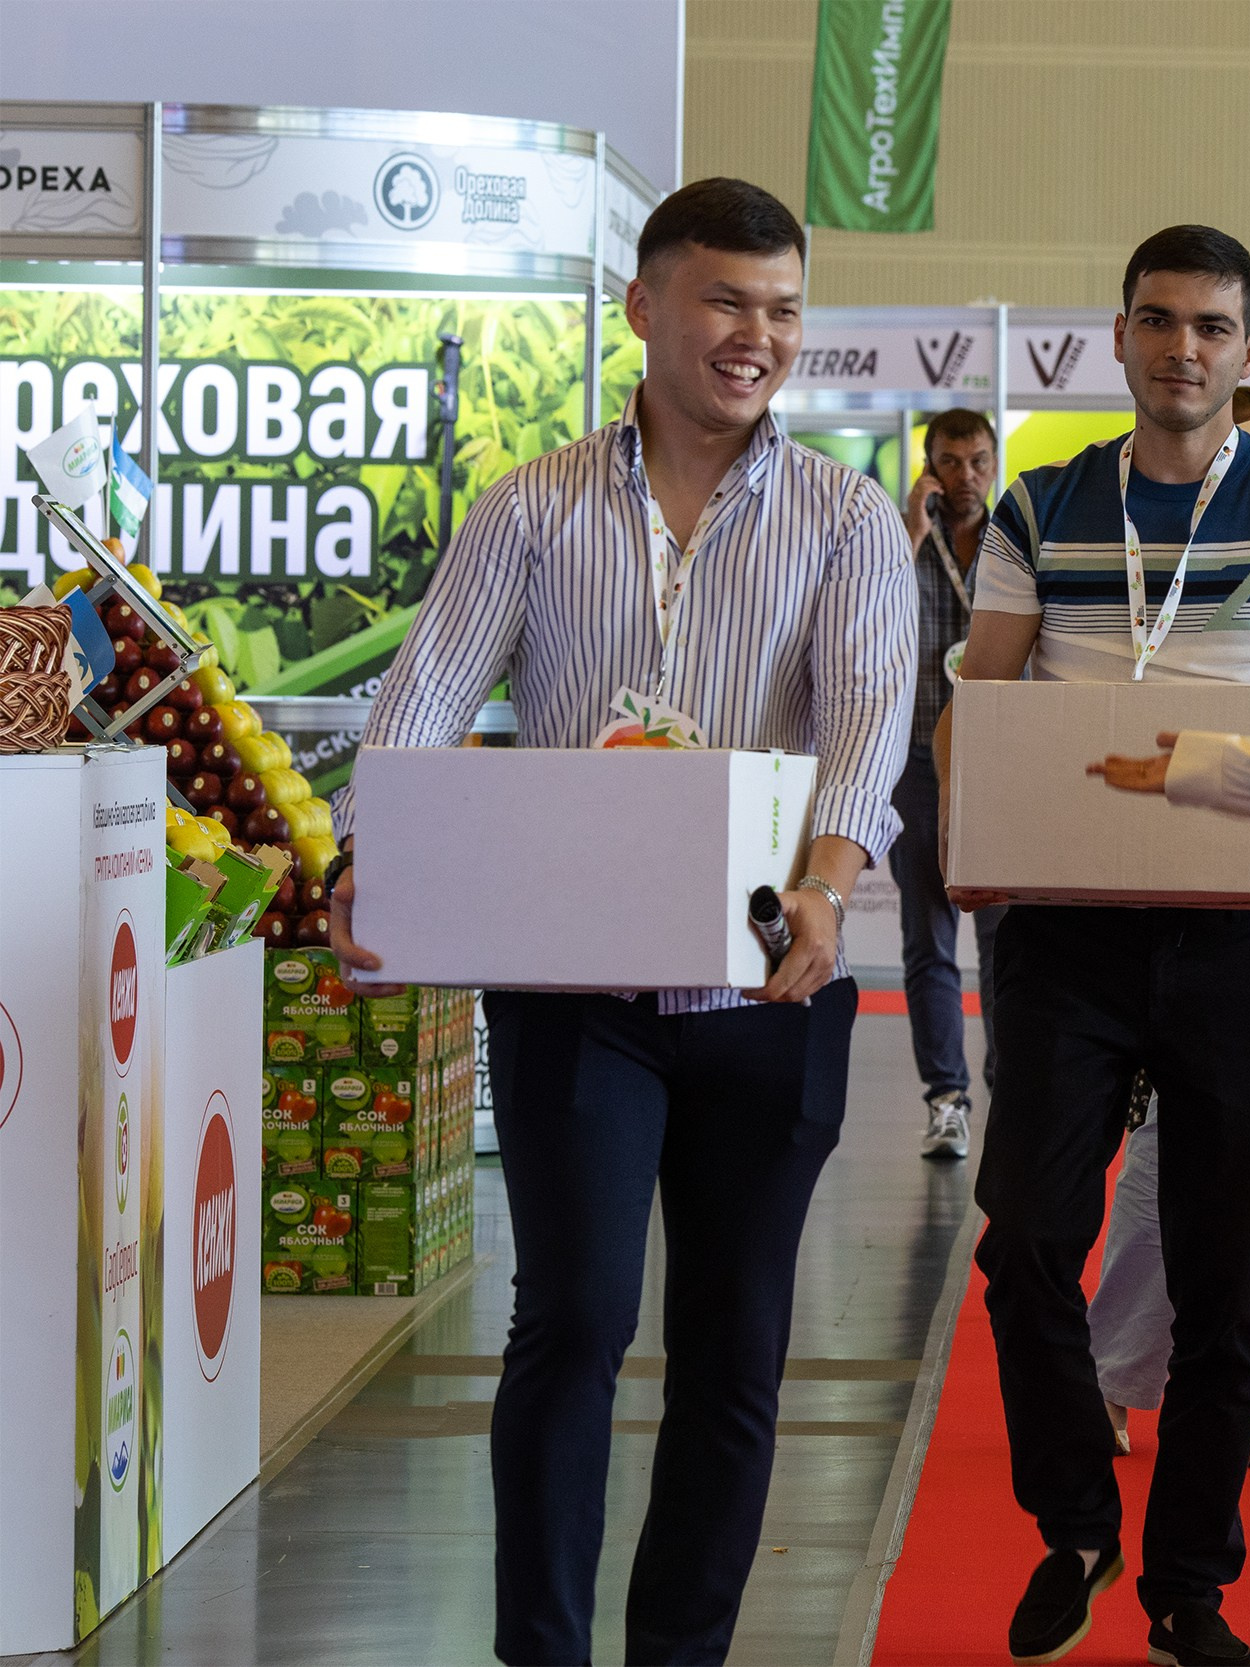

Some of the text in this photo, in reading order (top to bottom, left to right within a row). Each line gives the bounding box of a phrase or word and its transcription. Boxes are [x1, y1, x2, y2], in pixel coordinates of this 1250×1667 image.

[300, 993, 331, 1005] СОК
[282, 1005, 348, 1016] ЯБЛОЧНЫЙ
[262, 1109, 292, 1120] СОК
[357, 1110, 387, 1122] СОК
[338, 1121, 405, 1133] ЯБЛОЧНЫЙ
[297, 1224, 327, 1236] СОК
[279, 1236, 345, 1247] ЯБЛОЧНЫЙ
